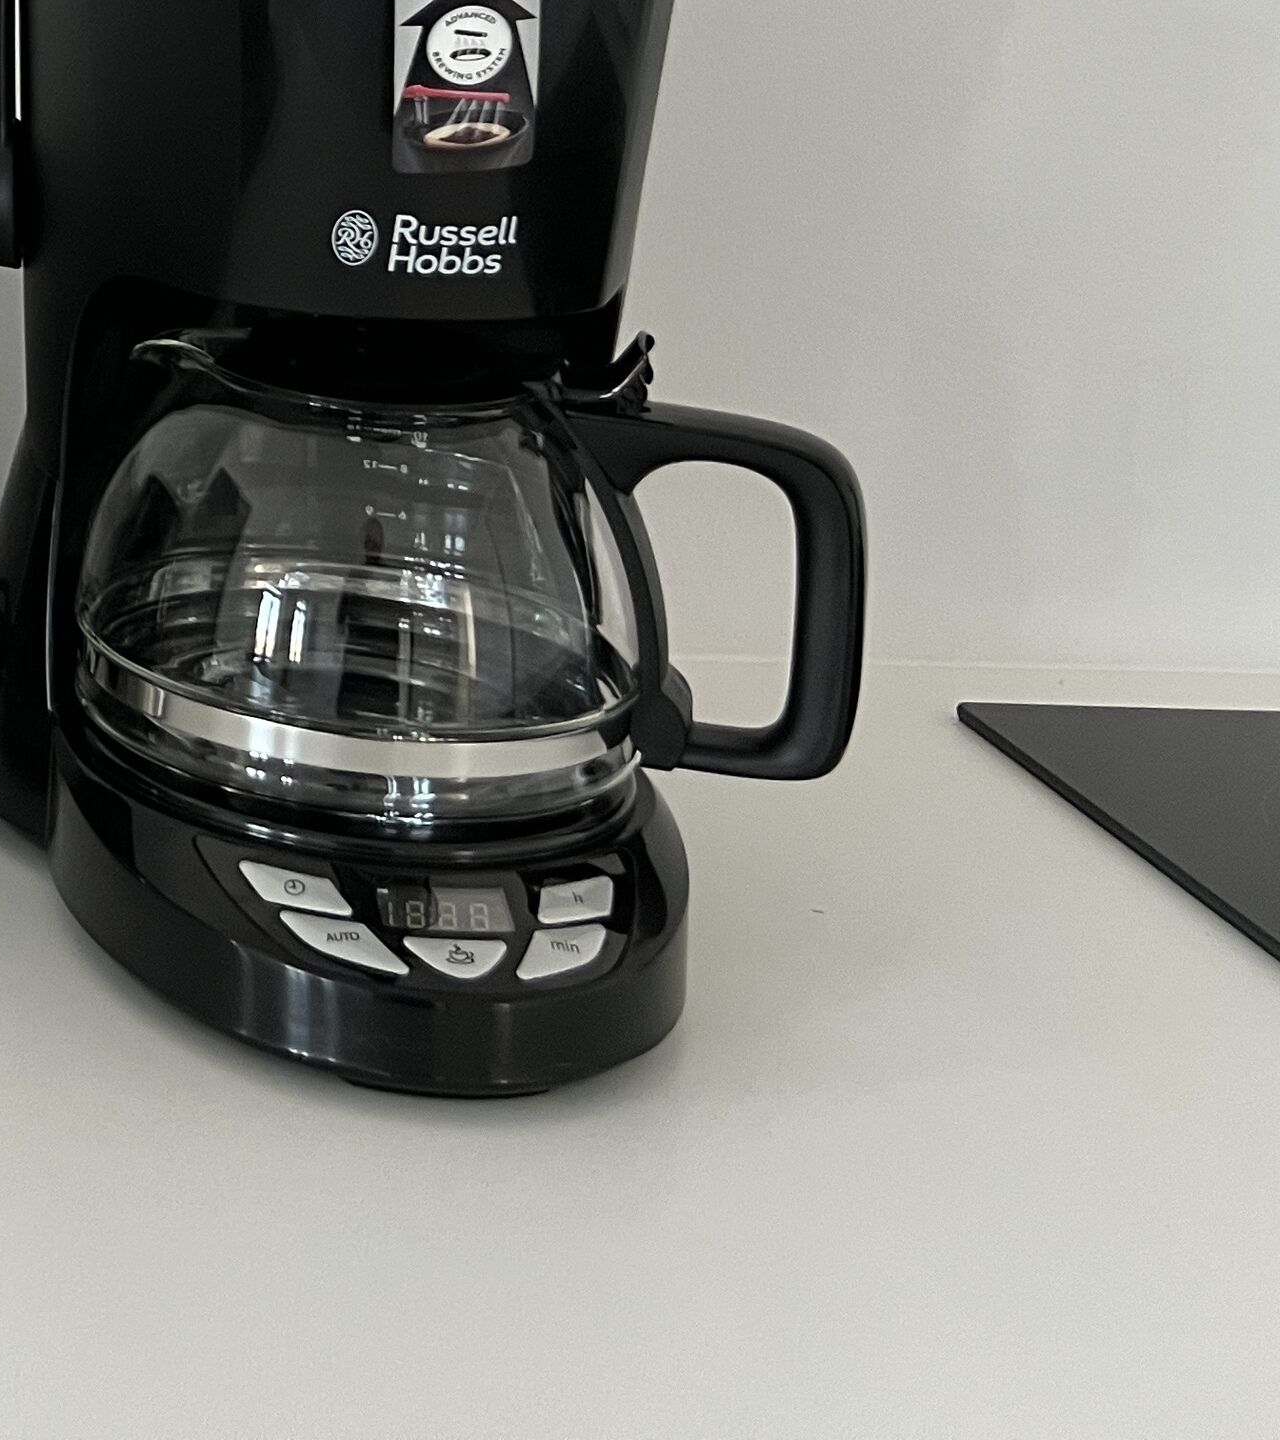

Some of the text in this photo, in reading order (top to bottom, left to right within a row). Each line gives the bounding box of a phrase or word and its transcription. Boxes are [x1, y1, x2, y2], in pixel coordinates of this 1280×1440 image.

[445, 12, 496, 27] ADVANCED
[432, 48, 507, 79] BREWING SYSTEM
[392, 214, 518, 246] Russell
[388, 244, 502, 275] Hobbs
[571, 891, 584, 904] h
[327, 931, 360, 942] AUTO
[550, 940, 580, 954] min
